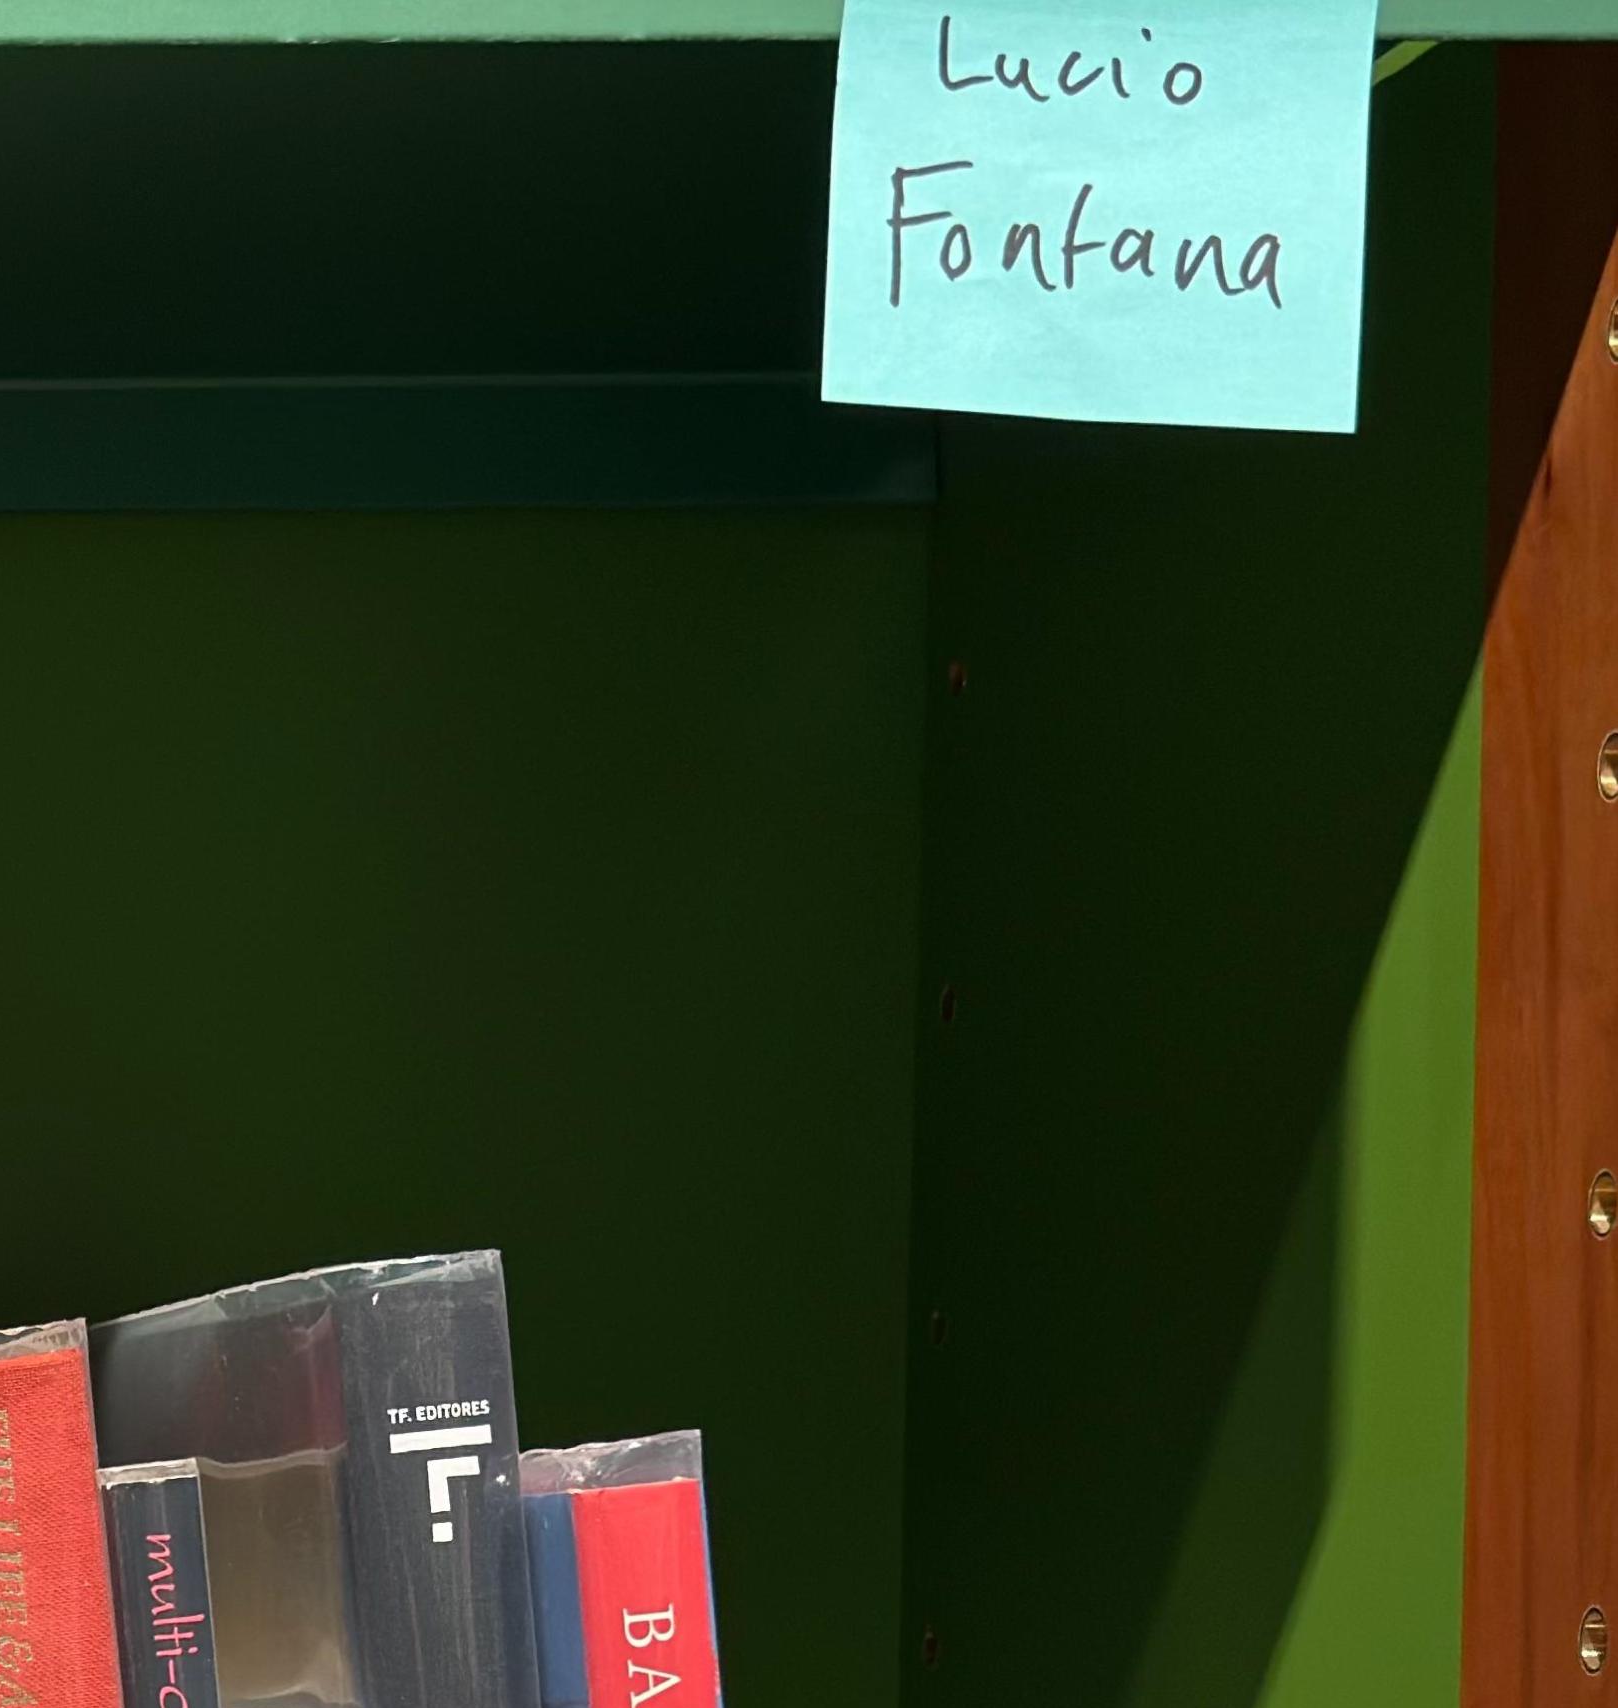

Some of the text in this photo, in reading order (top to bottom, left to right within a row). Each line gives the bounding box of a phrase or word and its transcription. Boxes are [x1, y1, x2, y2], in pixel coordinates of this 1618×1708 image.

[939, 15, 1202, 104] Lucio
[886, 160, 1281, 309] Fontana
[387, 1399, 490, 1424] TF. EDITORES
